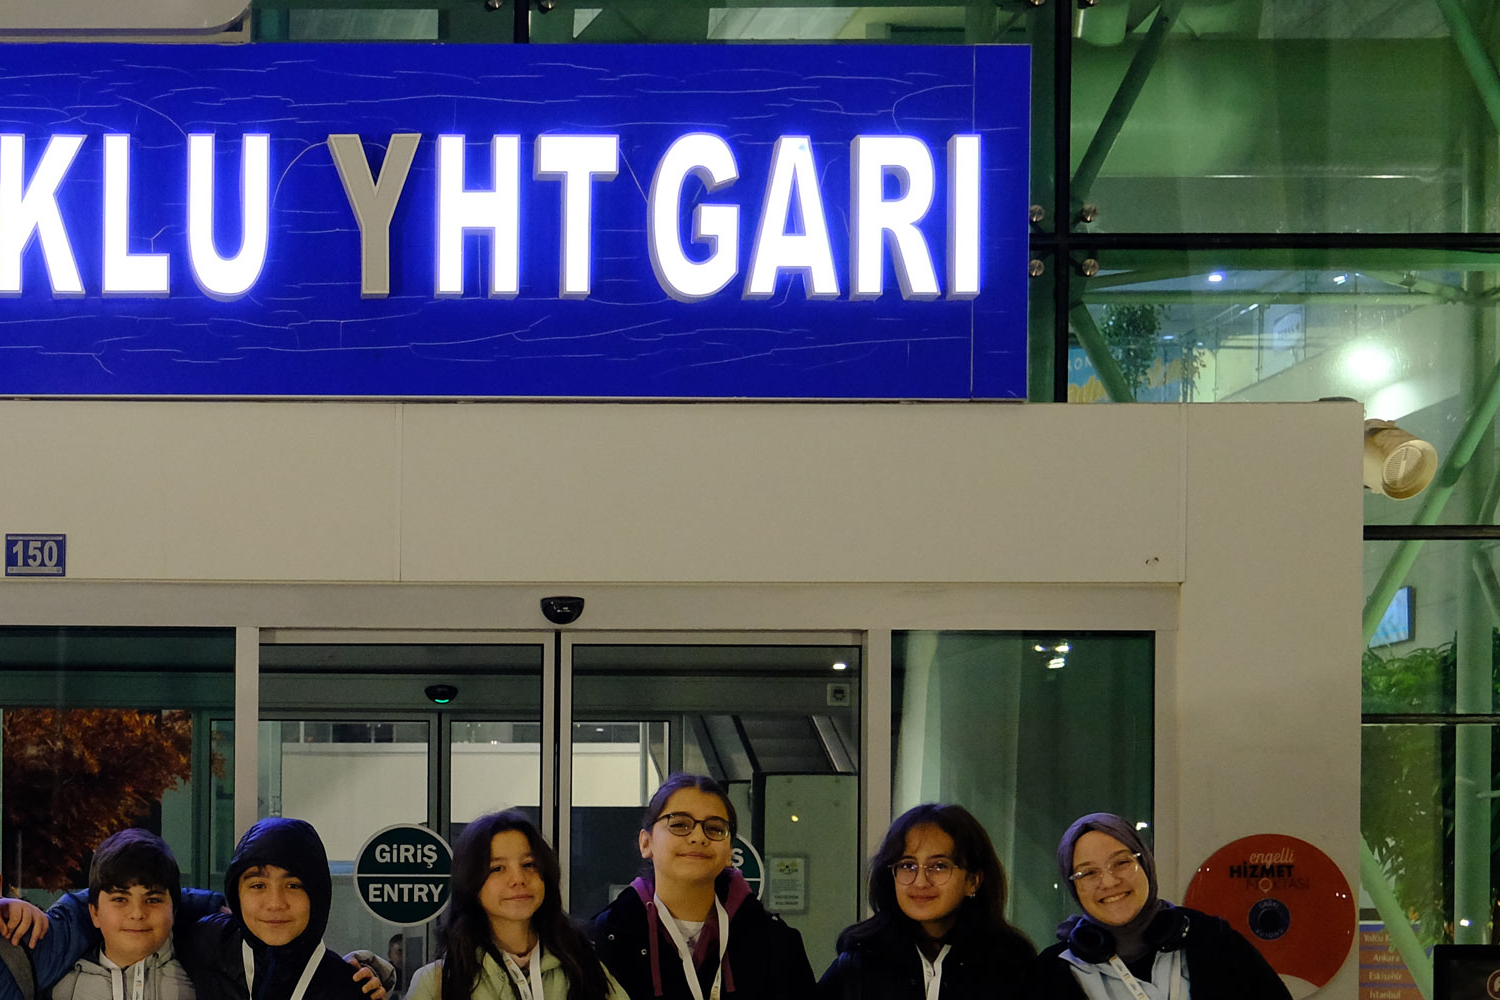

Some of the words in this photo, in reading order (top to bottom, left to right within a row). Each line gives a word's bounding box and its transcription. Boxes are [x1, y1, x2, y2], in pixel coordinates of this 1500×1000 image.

[326, 132, 621, 301] YHT
[647, 132, 982, 302] GARI
[12, 540, 58, 567] 150
[1249, 848, 1296, 869] engelli
[1229, 861, 1294, 878] HİZMET
[368, 883, 444, 902] ENTRY
[1373, 953, 1400, 962] Ankara
